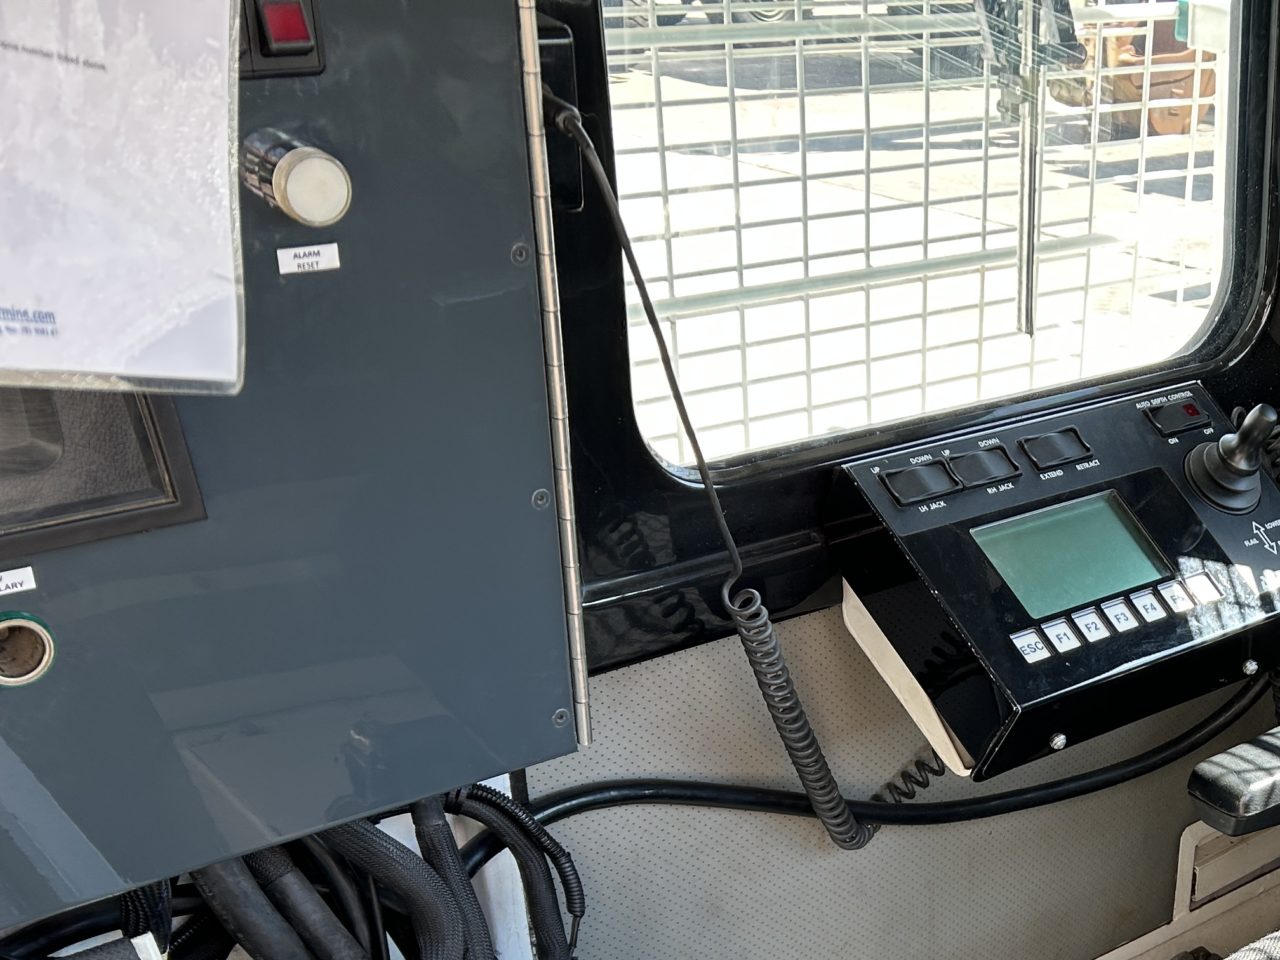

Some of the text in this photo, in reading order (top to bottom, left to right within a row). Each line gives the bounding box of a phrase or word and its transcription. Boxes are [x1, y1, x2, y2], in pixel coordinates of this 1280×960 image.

[293, 250, 320, 260] ALARM
[297, 261, 319, 271] RESET
[1135, 401, 1151, 409] AUTO
[1167, 390, 1194, 401] CONTROL
[1203, 427, 1214, 435] OFF
[978, 437, 1000, 448] DOWN
[1168, 437, 1179, 445] ON
[941, 449, 951, 457] UP
[909, 453, 933, 465] DOWN
[1075, 459, 1100, 470] RETRACT
[870, 466, 880, 474] UP
[1039, 469, 1064, 480] EXTEND
[986, 482, 1015, 495] RH JACK
[929, 500, 947, 510] JACK
[1142, 602, 1157, 614] F4
[1114, 612, 1129, 623] F3
[1084, 621, 1100, 632] F2
[1055, 632, 1071, 643] F1
[1020, 641, 1044, 656] ESC
